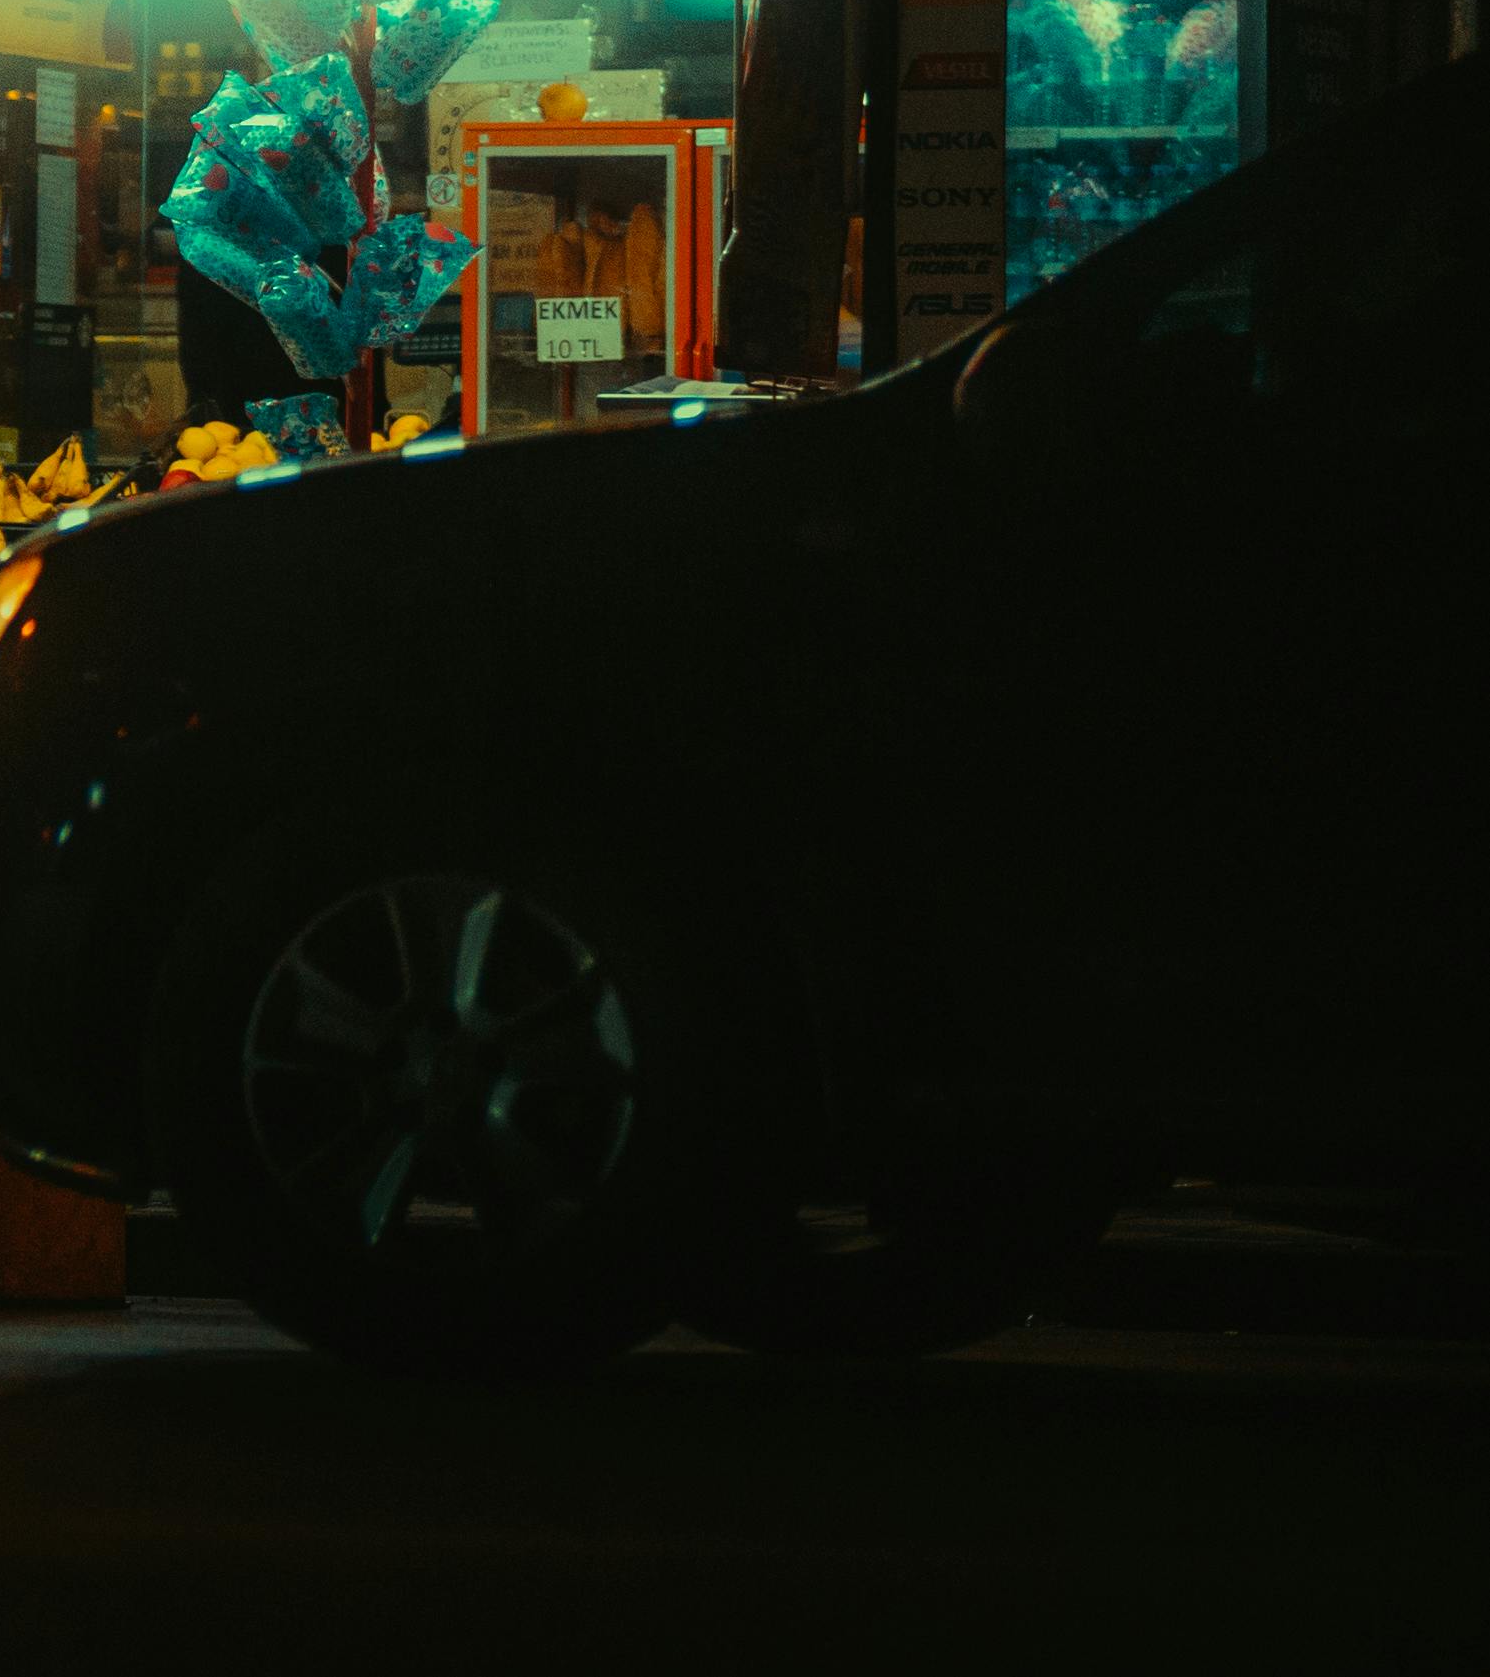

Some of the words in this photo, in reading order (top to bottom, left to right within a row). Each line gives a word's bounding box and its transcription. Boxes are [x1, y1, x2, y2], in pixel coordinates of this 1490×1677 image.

[899, 131, 997, 150] NOKIA
[898, 187, 999, 208] SONY
[898, 242, 1001, 257] GENERAL
[906, 260, 992, 275] MOBILE
[538, 300, 618, 321] EKMEK
[902, 292, 994, 316] ASUS
[547, 338, 573, 360] 10
[578, 337, 605, 359] TL
